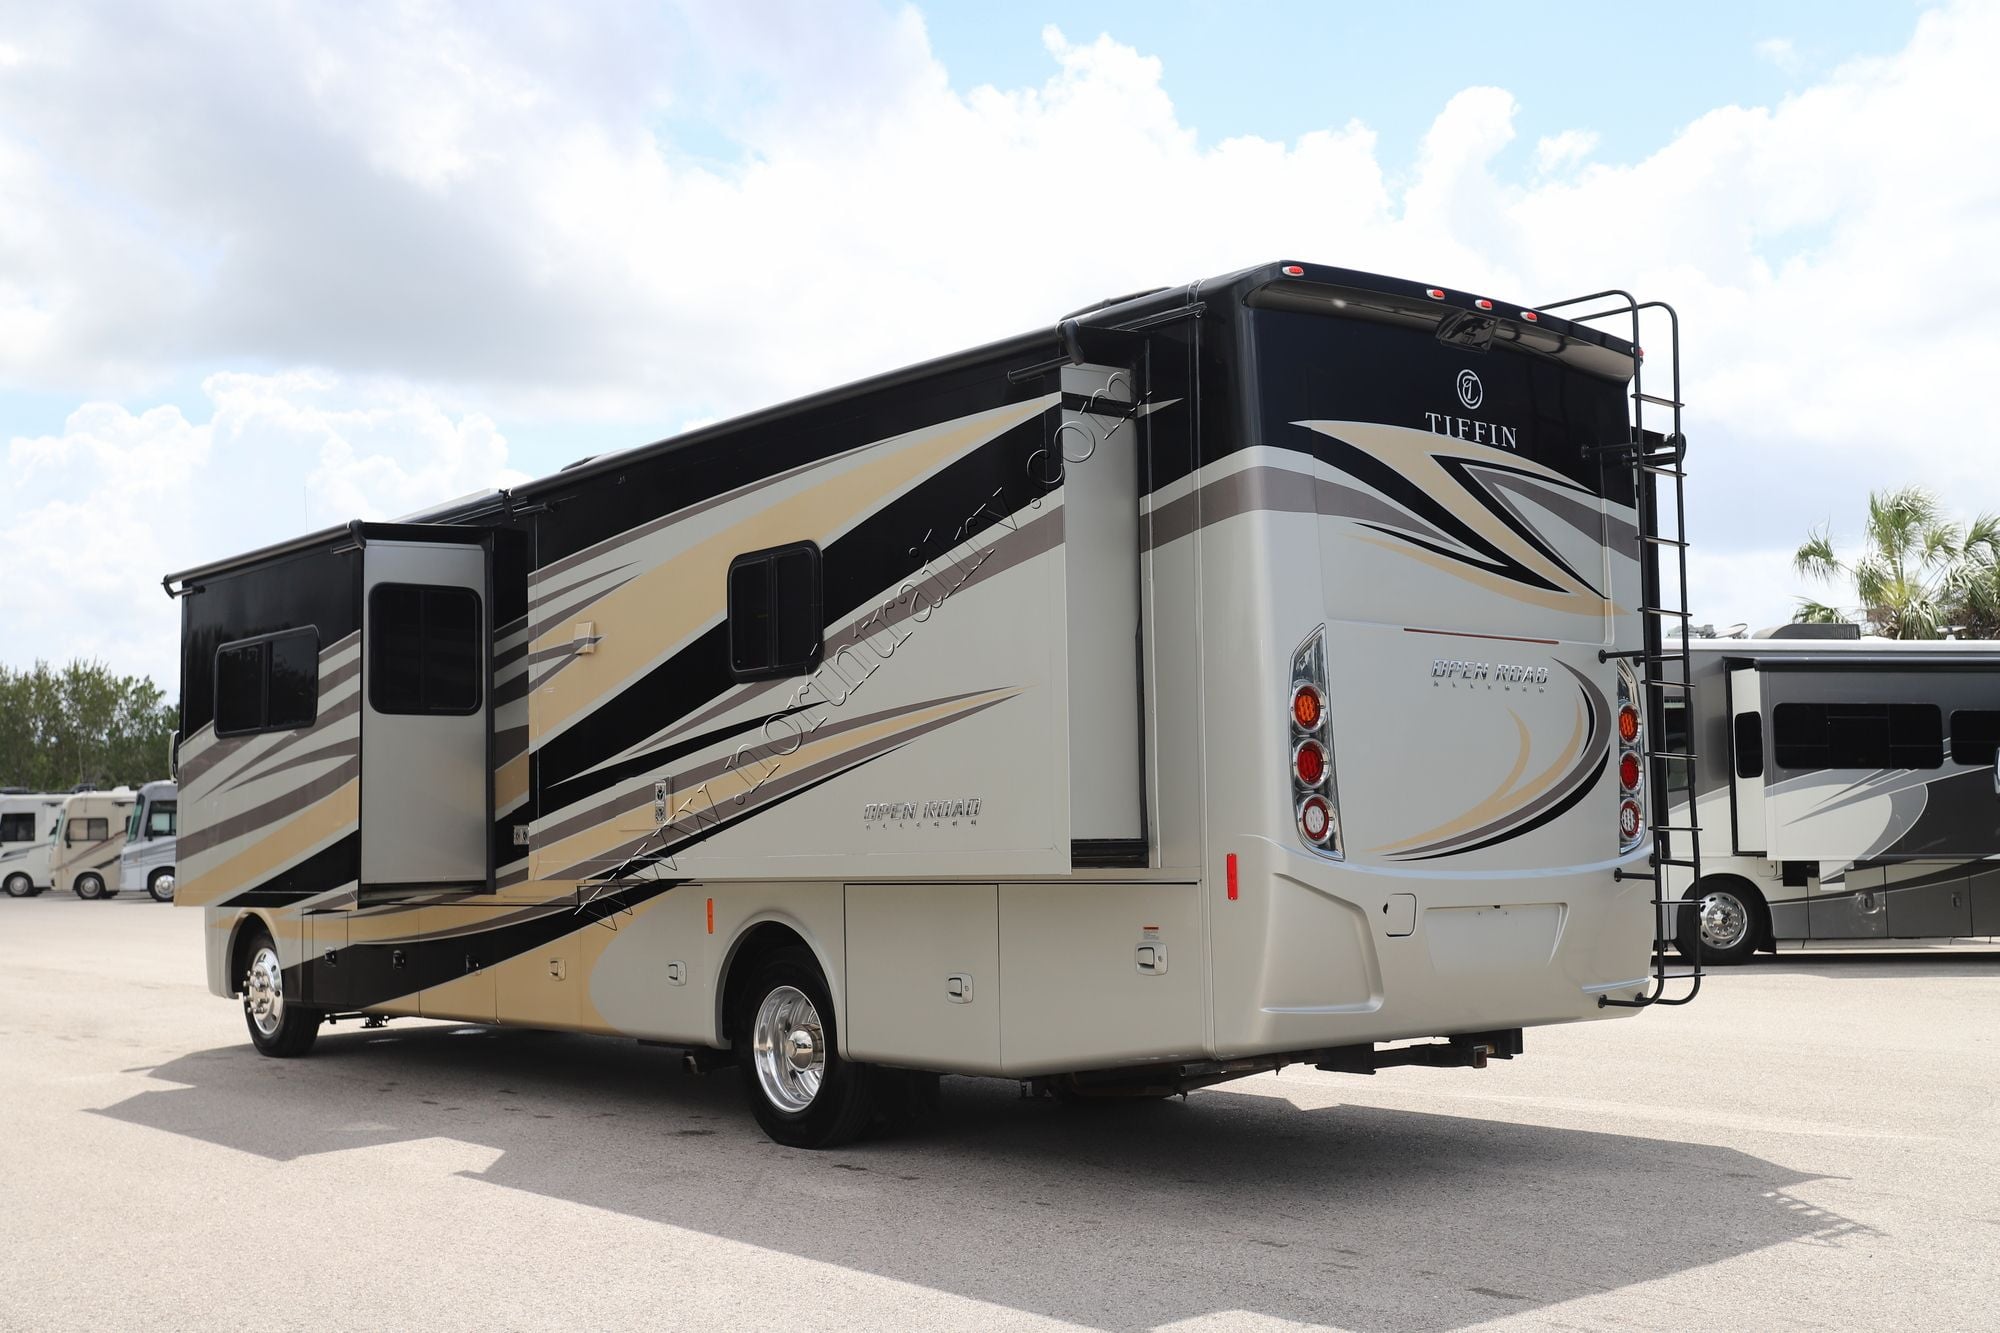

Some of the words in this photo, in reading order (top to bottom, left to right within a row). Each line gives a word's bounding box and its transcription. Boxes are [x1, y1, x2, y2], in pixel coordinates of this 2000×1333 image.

[1425, 411, 1518, 449] TIFFIN
[1431, 659, 1489, 681] OPEN
[1495, 663, 1549, 684] ROAD
[863, 802, 918, 822] OPEN
[923, 798, 982, 819] ROAD
